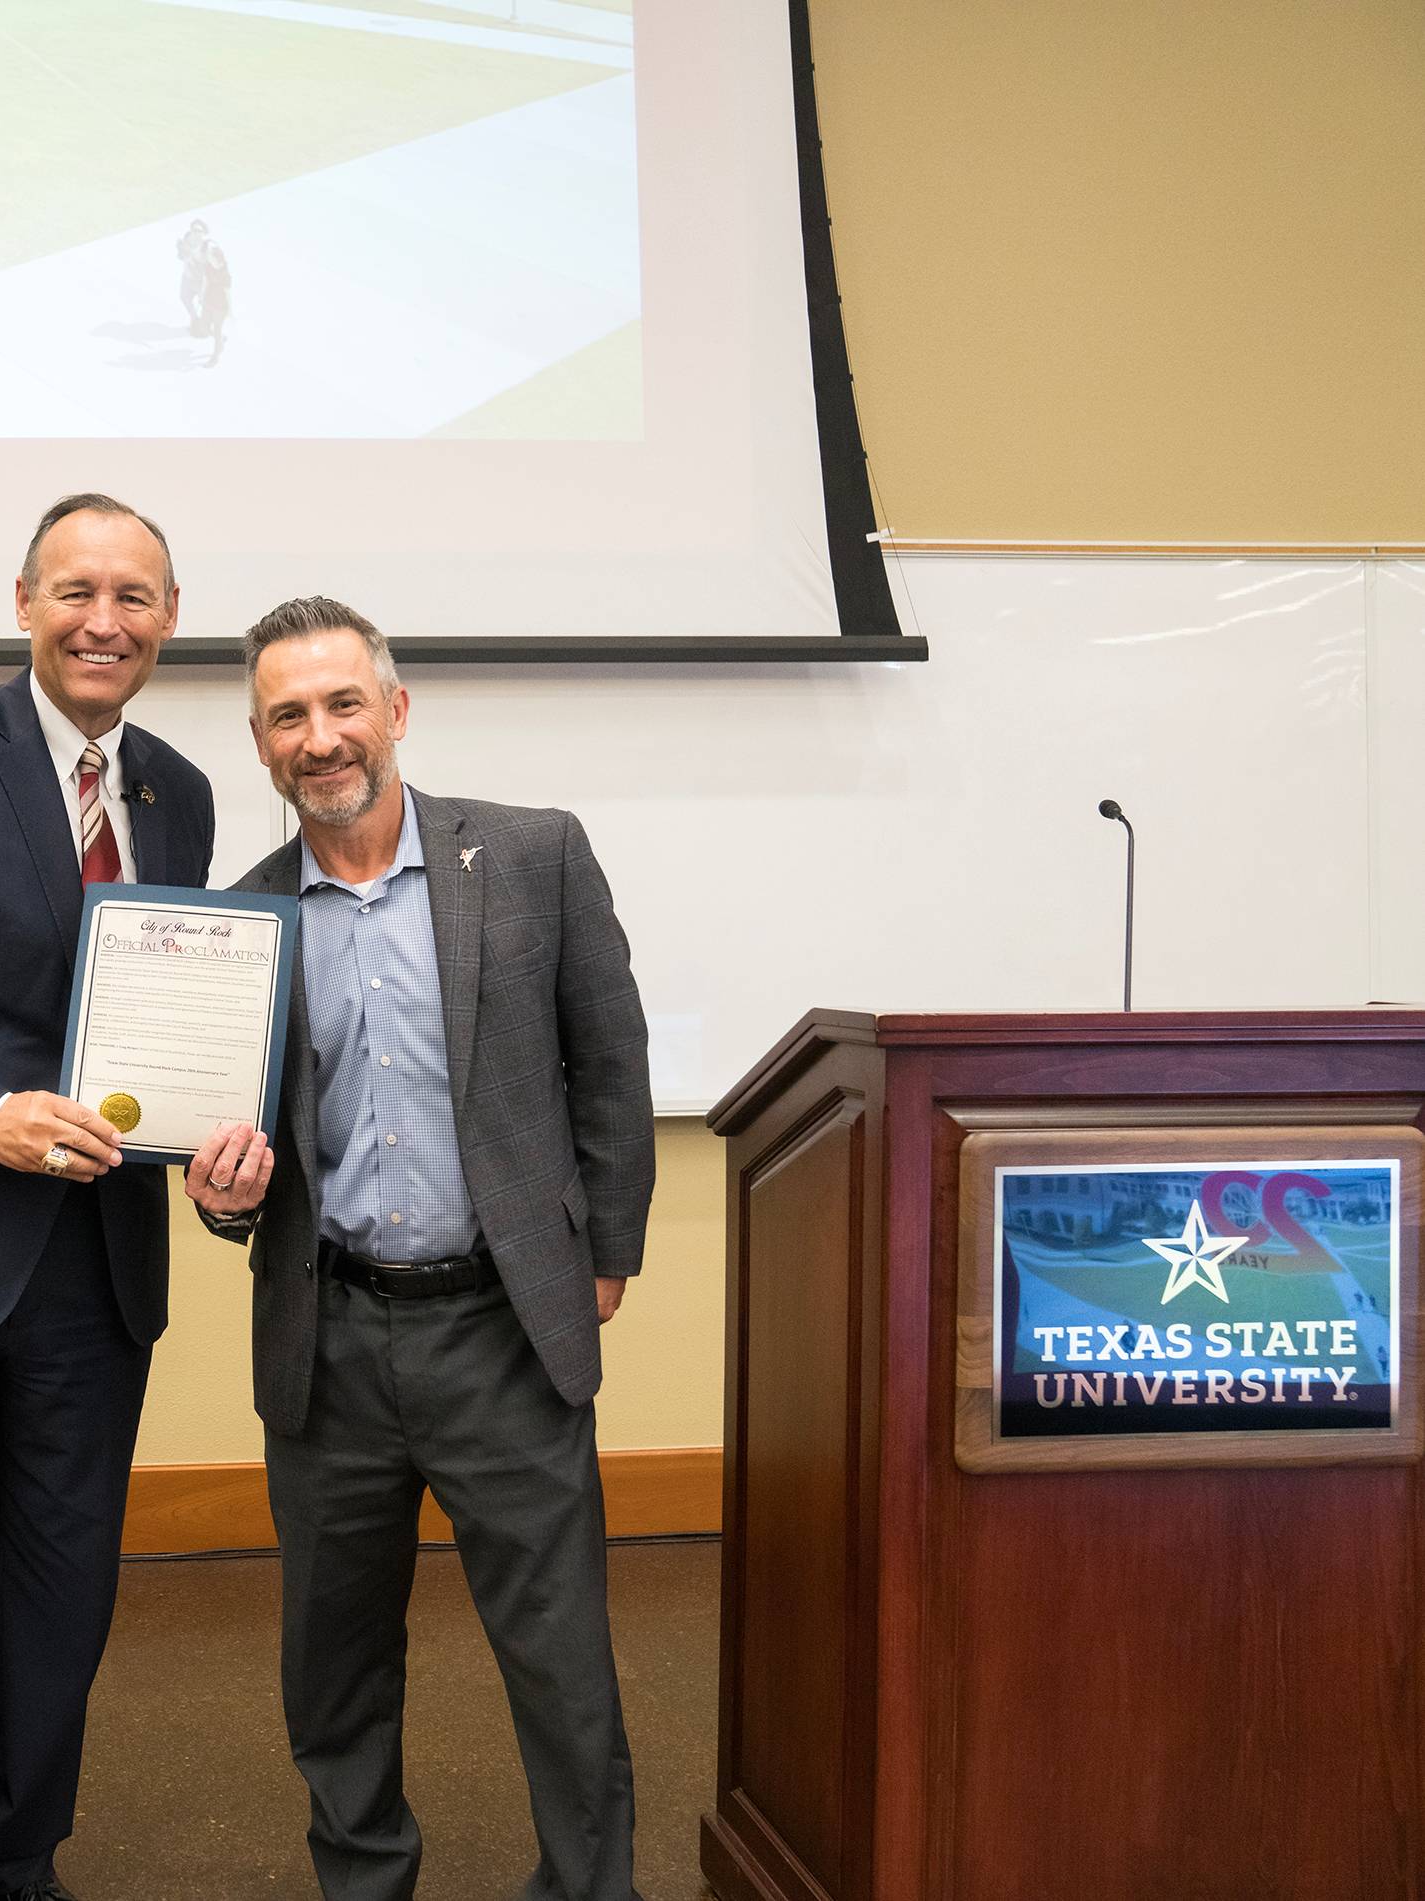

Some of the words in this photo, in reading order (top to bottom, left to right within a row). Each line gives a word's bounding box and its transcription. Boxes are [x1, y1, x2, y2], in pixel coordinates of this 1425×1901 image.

[140, 919, 158, 935] City
[158, 921, 173, 935] of
[171, 920, 205, 936] Round
[206, 924, 233, 938] Rock
[1034, 1323, 1192, 1362] TEXAS
[1205, 1319, 1358, 1358] STATE
